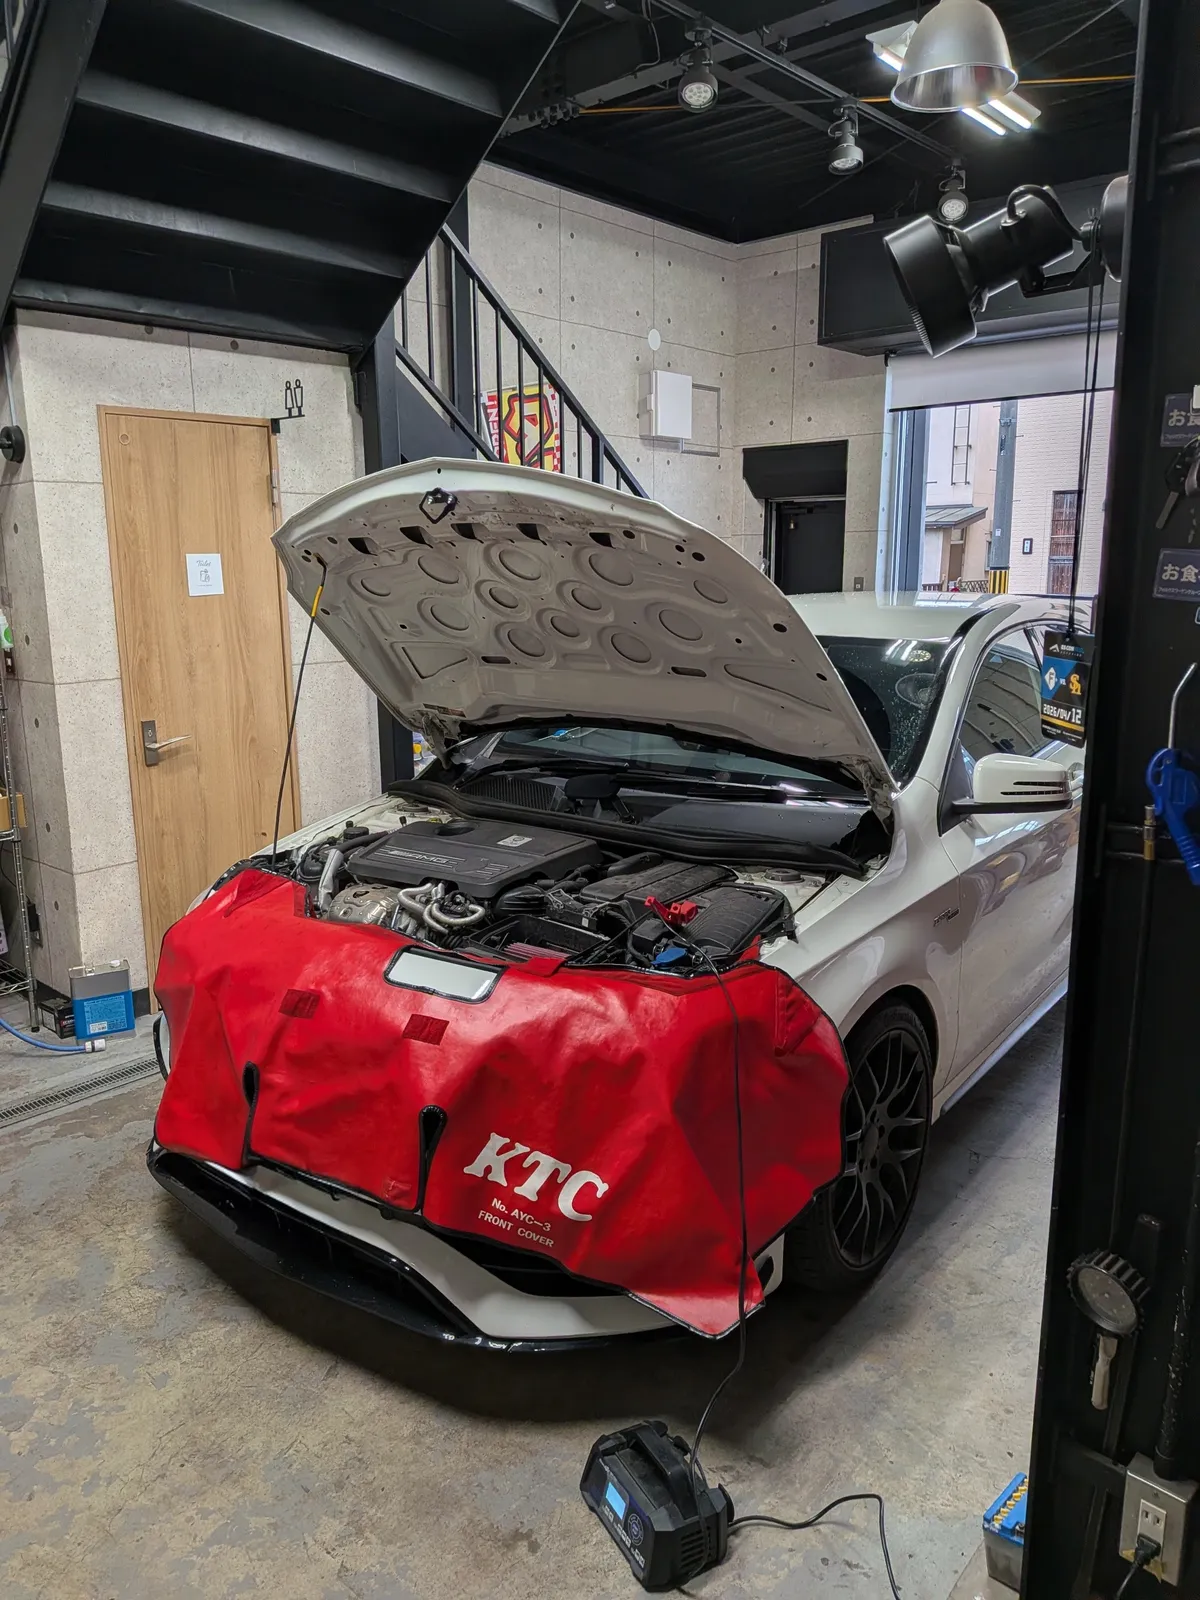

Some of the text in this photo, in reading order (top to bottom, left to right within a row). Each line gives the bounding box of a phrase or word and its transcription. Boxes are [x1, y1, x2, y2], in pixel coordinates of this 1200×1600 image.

[1162, 563, 1200, 583] お食
[1043, 704, 1082, 724] 2026/04/12
[463, 1132, 610, 1222] KTC
[478, 1209, 554, 1248] FRONT COVER
[491, 1197, 552, 1232] No. AYC-3
